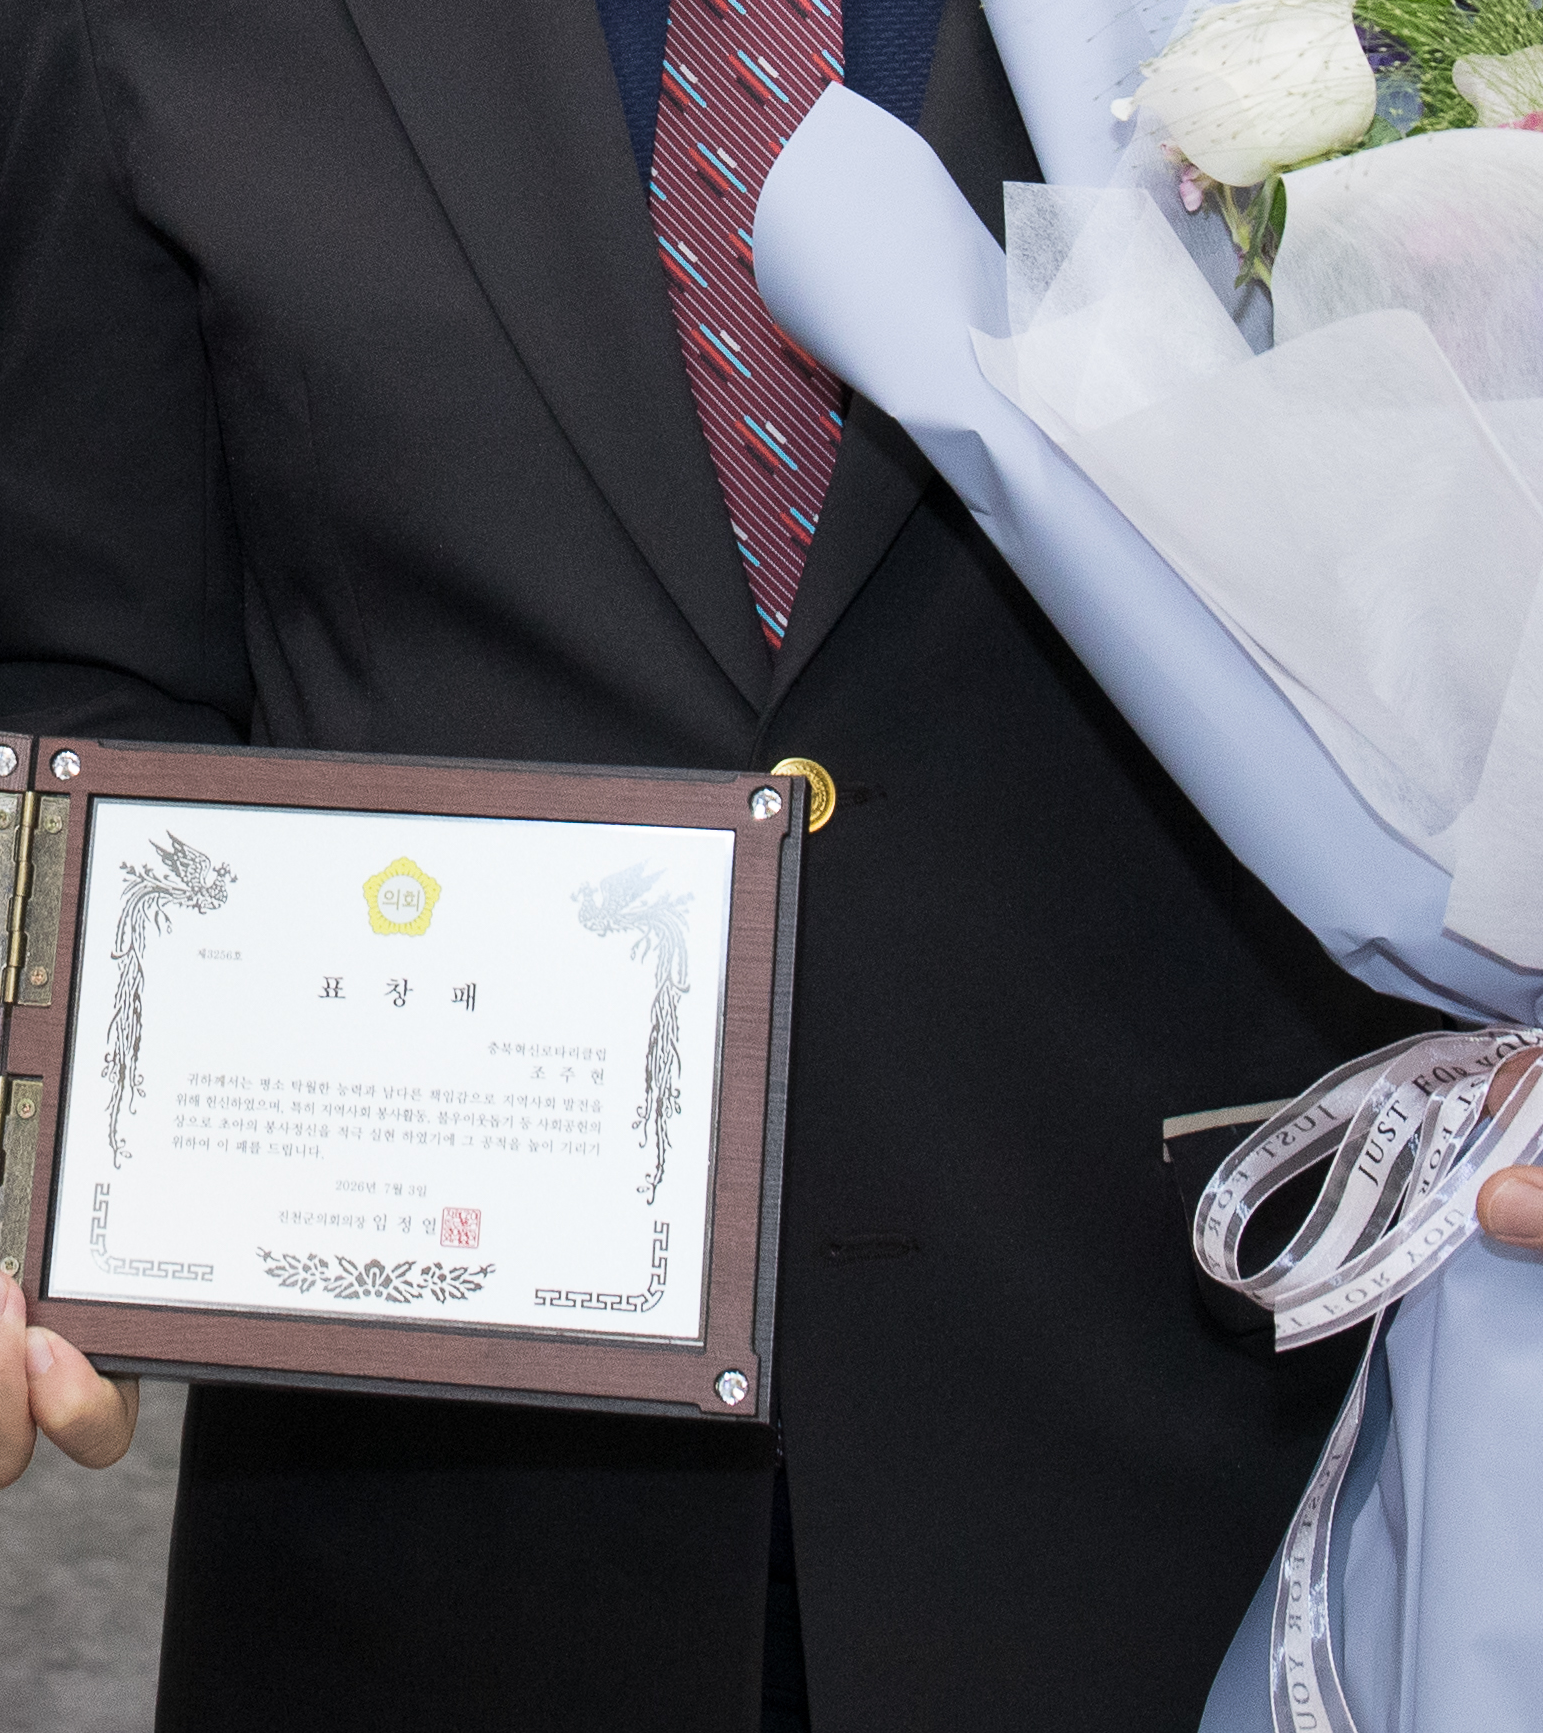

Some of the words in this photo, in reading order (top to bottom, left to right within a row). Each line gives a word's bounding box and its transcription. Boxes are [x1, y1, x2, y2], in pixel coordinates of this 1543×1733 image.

[381, 887, 421, 913] 의회
[318, 976, 346, 1000] 표
[384, 977, 414, 1008] 창
[451, 982, 478, 1013] 패
[175, 1093, 201, 1108] 위해
[206, 1094, 285, 1115] 헌신하였으며,
[290, 1099, 316, 1116] 특히
[322, 1102, 372, 1120] 지역사회
[377, 1106, 431, 1124] 봉사활동,
[437, 1111, 514, 1129] 불우이웃돕기
[519, 1117, 533, 1131] 등
[187, 1073, 253, 1090] 귀하께서는
[260, 1077, 285, 1092] 평소
[292, 1080, 331, 1096] 탁월한
[337, 1082, 378, 1099] 능력과
[383, 1085, 422, 1102] 남다른
[430, 1089, 496, 1106] 책임감으로
[503, 1093, 557, 1110] 지역사회
[563, 1097, 604, 1114] 발전을
[172, 1134, 211, 1151] 위하여
[217, 1138, 230, 1153] 이
[236, 1140, 262, 1156] 패를
[266, 1142, 325, 1161] 드립니다.
[264, 1120, 332, 1138] 봉사정신을
[337, 1126, 364, 1141] 적극
[402, 1130, 456, 1147] 하였기에
[462, 1135, 475, 1146] 그
[528, 1137, 554, 1154] 높이
[561, 1140, 601, 1157] 기리기
[1358, 1098, 1411, 1186] JUST
[335, 1179, 377, 1195] 2026년
[383, 1182, 404, 1197] 7월
[408, 1184, 428, 1198] 3일
[278, 1209, 366, 1230] 진천군의회의장
[373, 1213, 388, 1232] 임
[397, 1215, 412, 1234] 정
